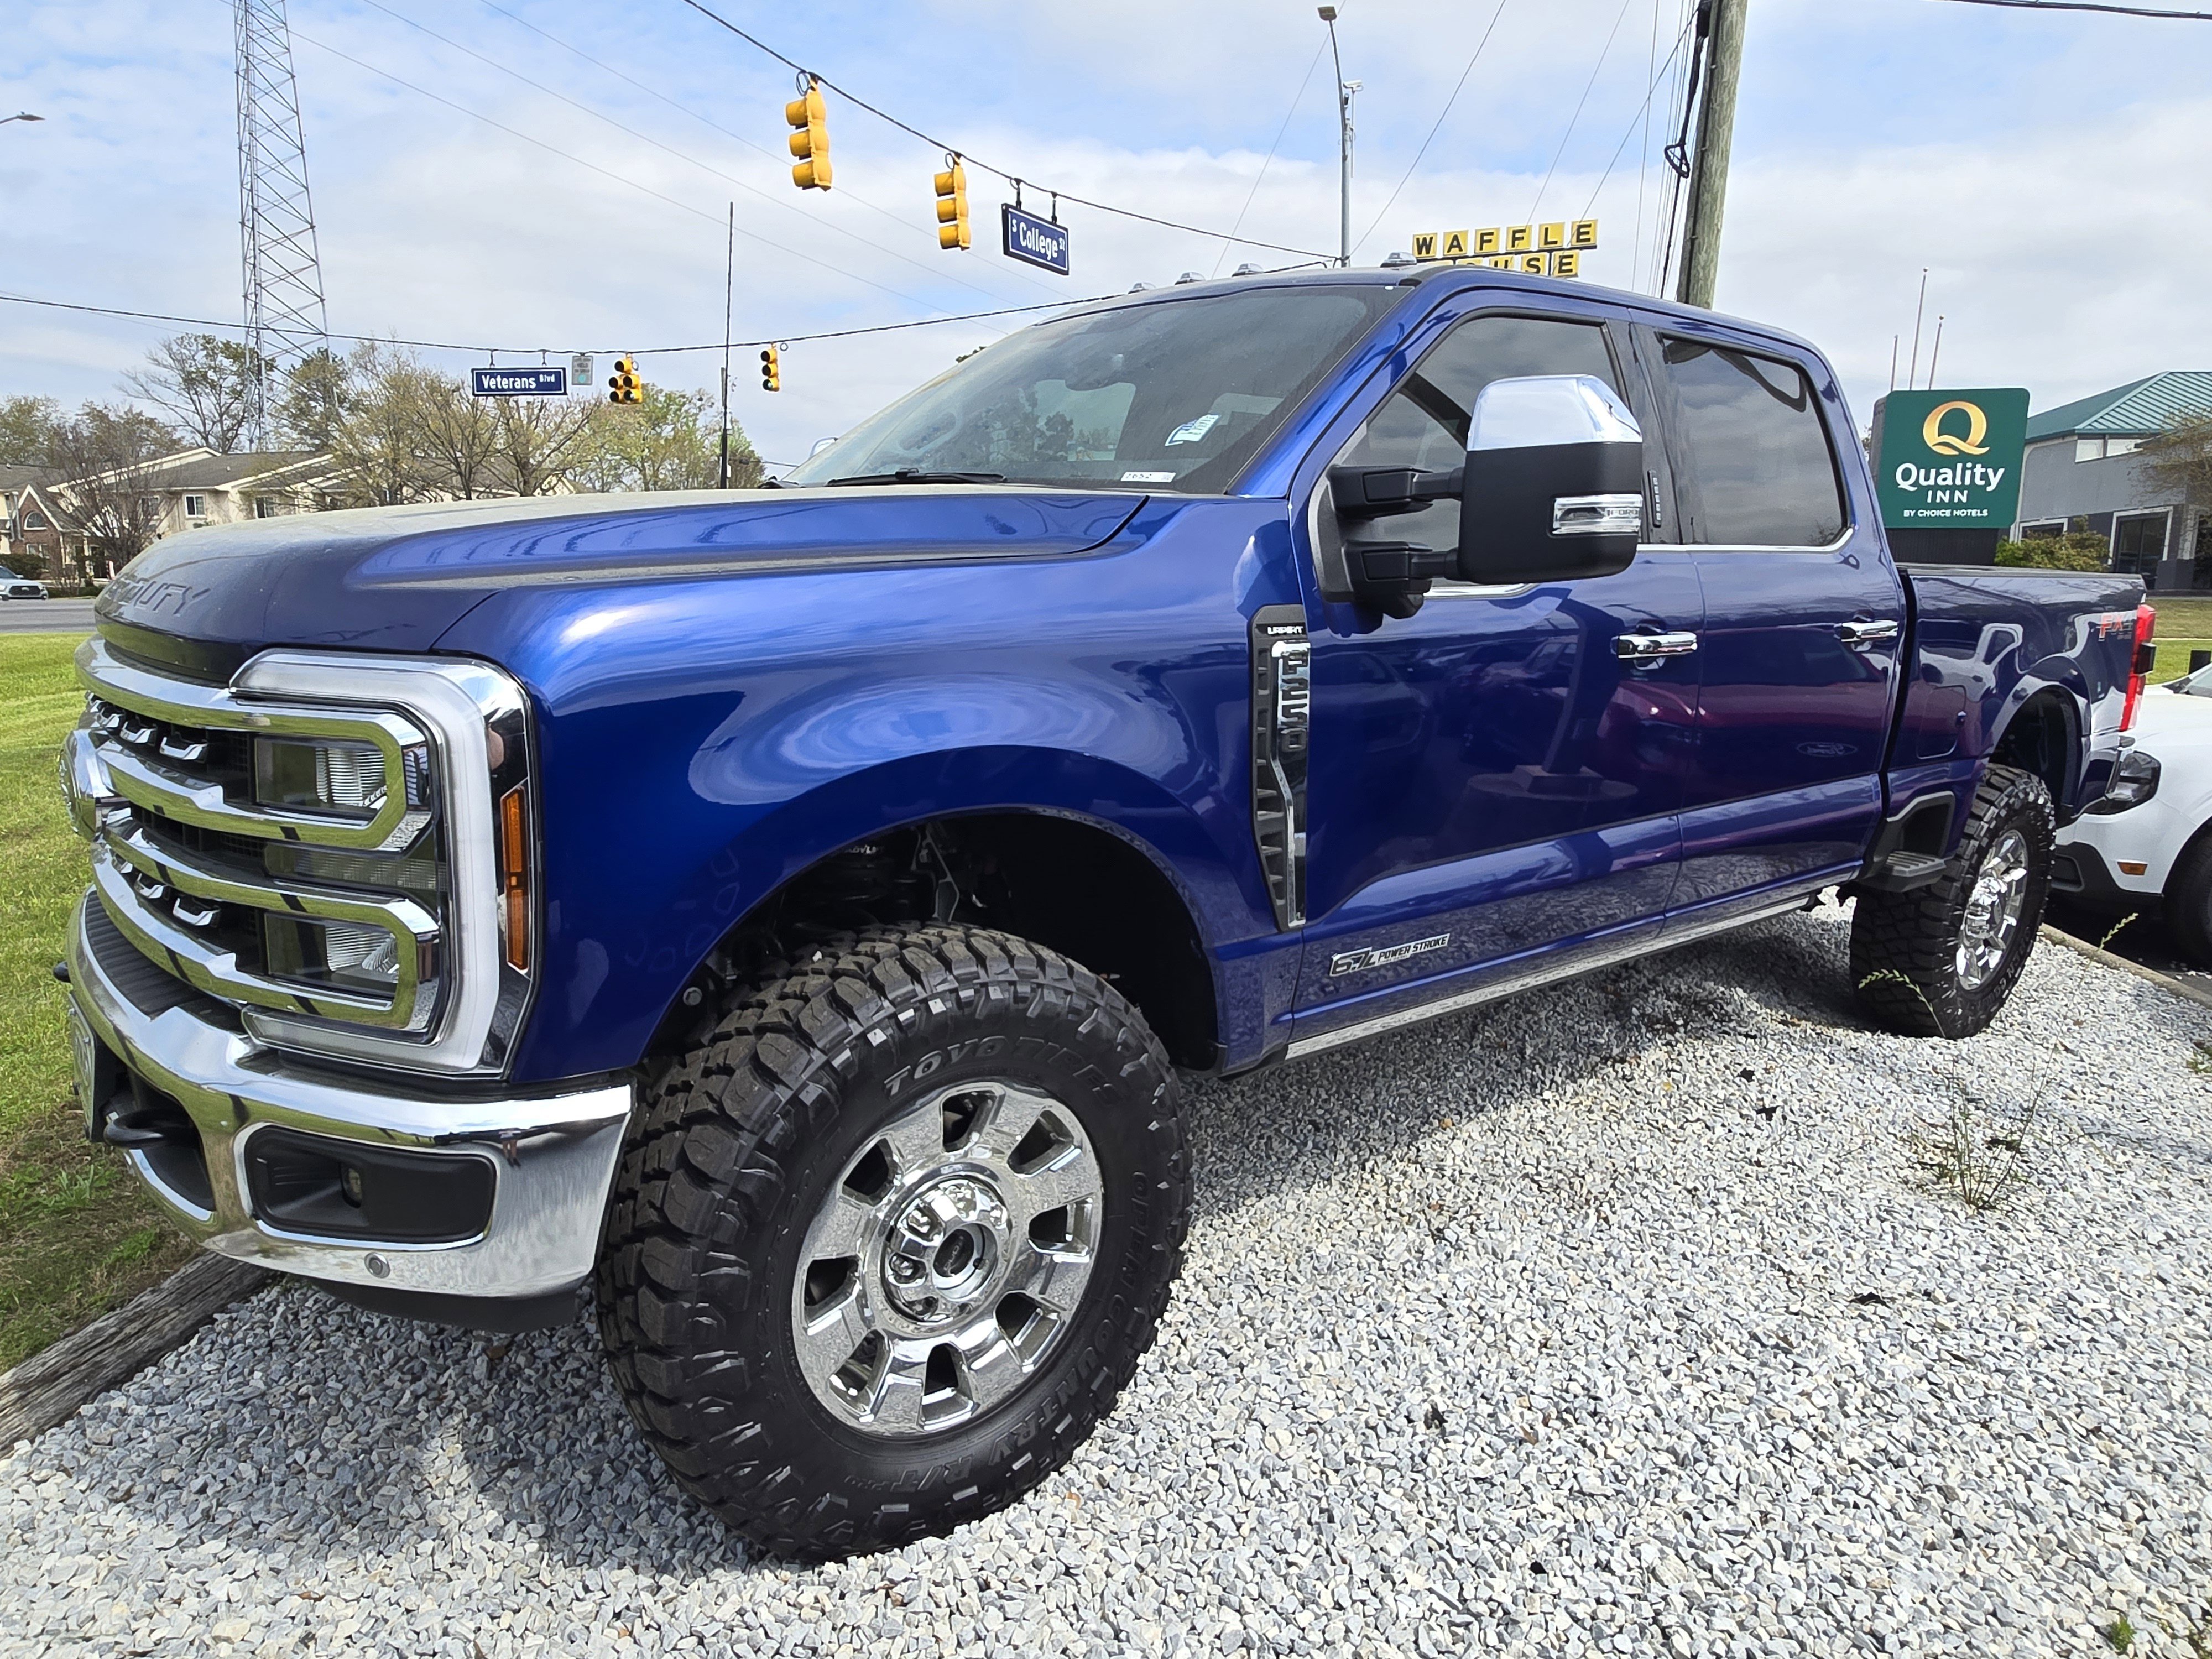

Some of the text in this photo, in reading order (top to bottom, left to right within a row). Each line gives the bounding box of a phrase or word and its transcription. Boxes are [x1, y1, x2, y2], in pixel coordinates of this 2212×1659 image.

[1011, 218, 1065, 260] S College St
[1416, 223, 1592, 255] WAFFLE
[481, 374, 555, 389] Veterans Blvd
[1923, 400, 1990, 455] Q
[1895, 462, 2005, 491] Quality
[1927, 489, 1968, 503] INN
[1378, 945, 1411, 962] POWER
[1412, 936, 1448, 953] STROKE
[883, 1035, 1125, 1107] TOYO TIRES
[1120, 1170, 1150, 1292] OPEN
[988, 1293, 1128, 1466] COUNTRY
